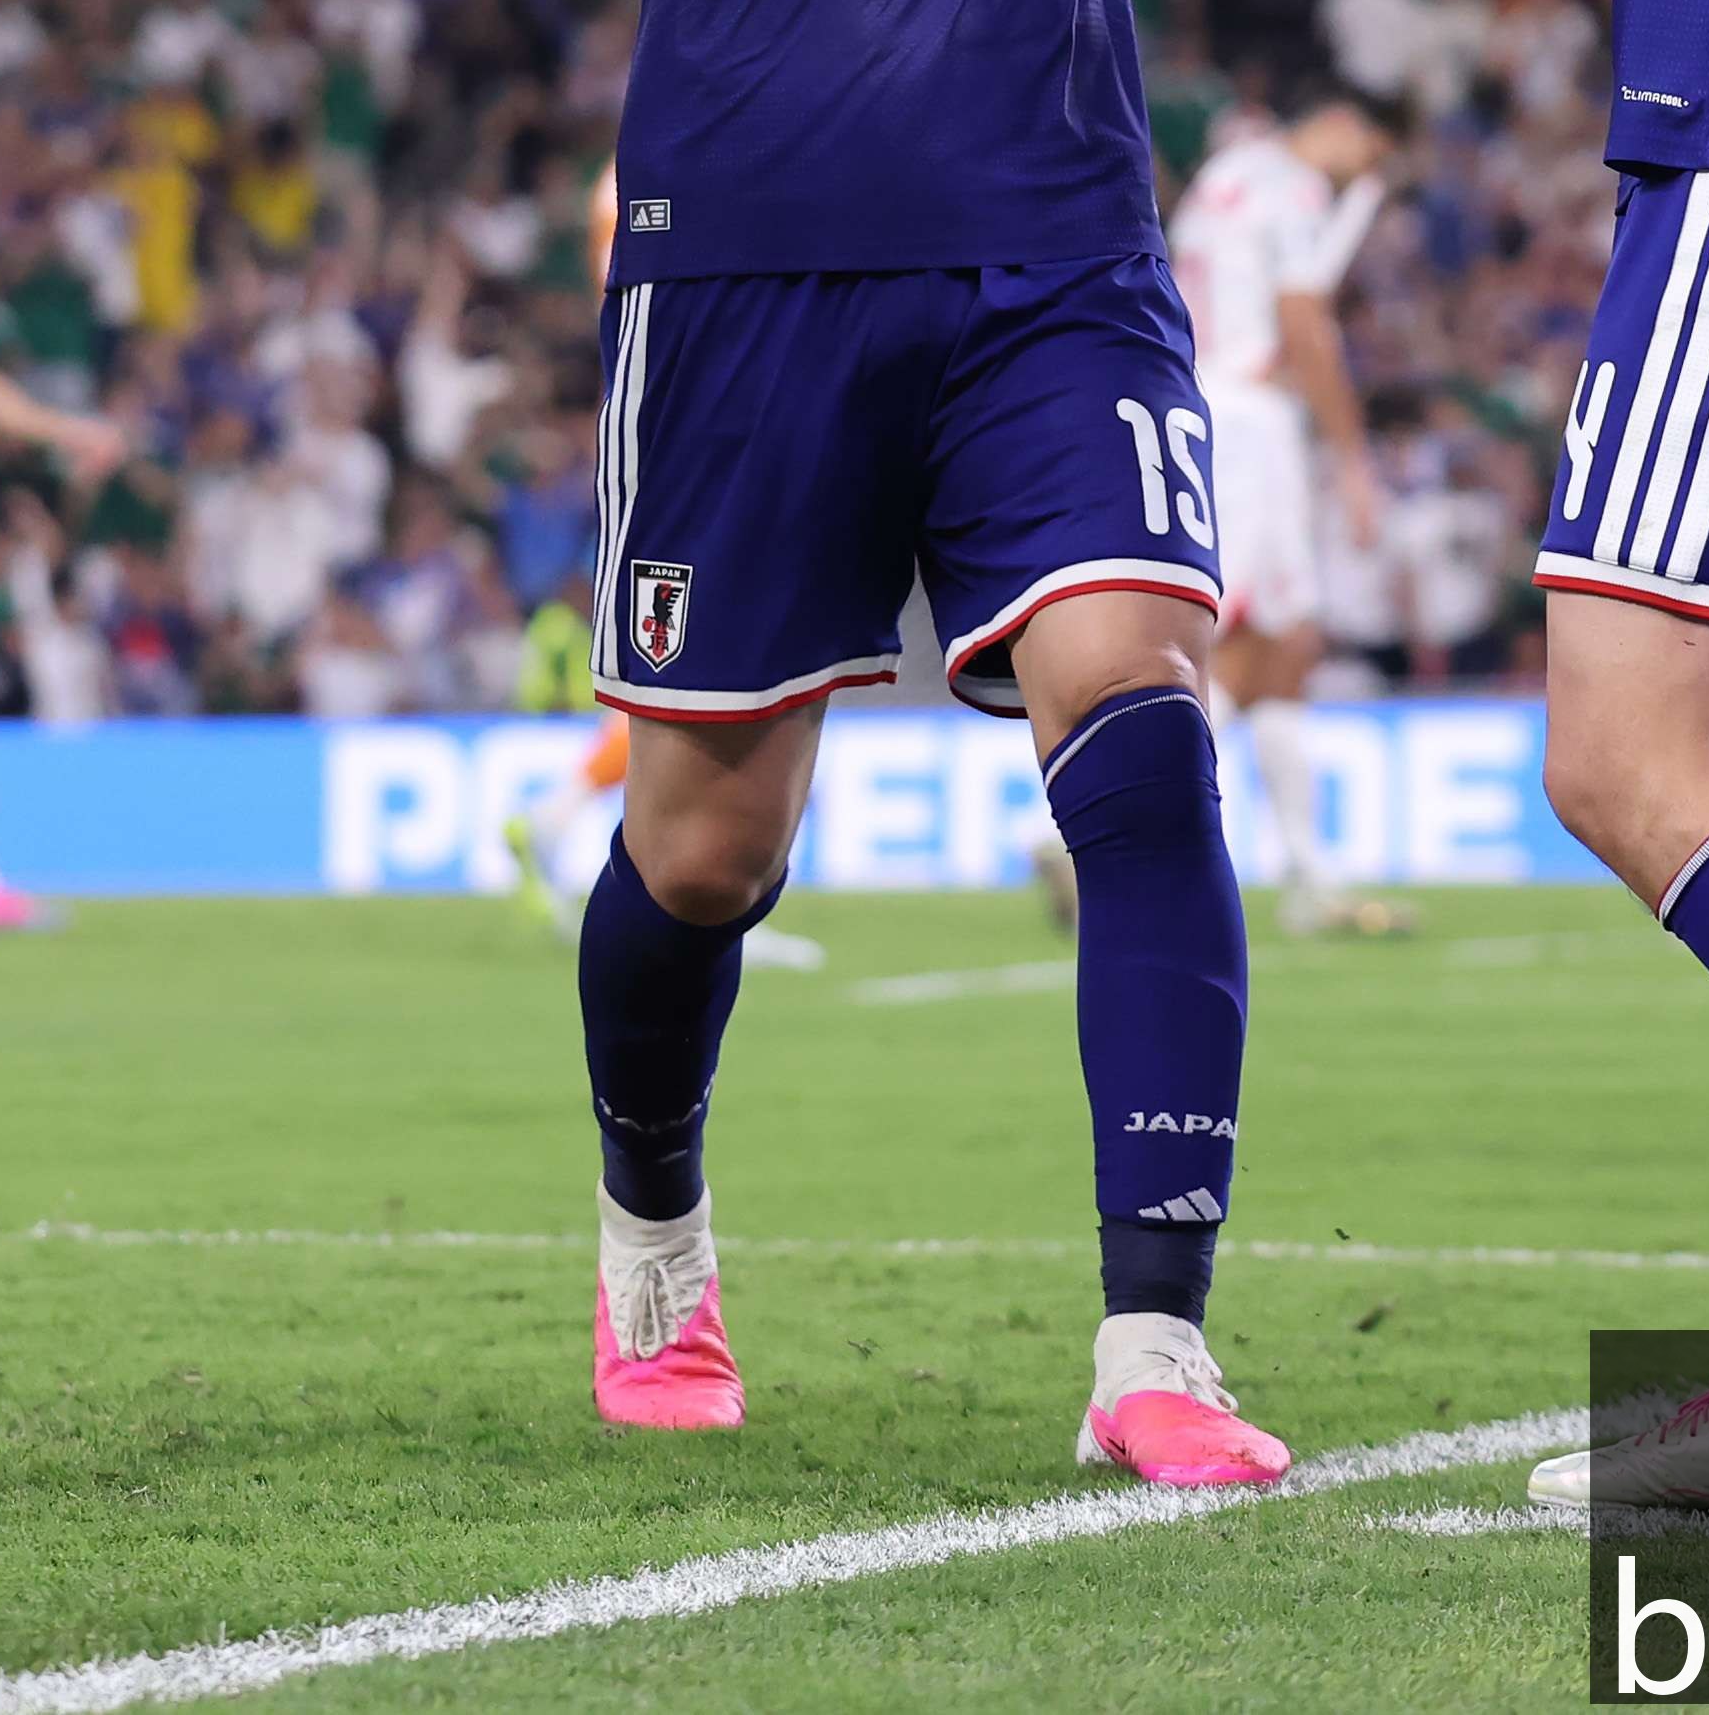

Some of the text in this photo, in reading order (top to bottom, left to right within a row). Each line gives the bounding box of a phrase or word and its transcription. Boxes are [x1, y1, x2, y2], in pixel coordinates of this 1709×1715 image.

[1116, 397, 1214, 551] 15
[648, 566, 682, 579] JAPAN
[1123, 1111, 1239, 1141] JAPA
